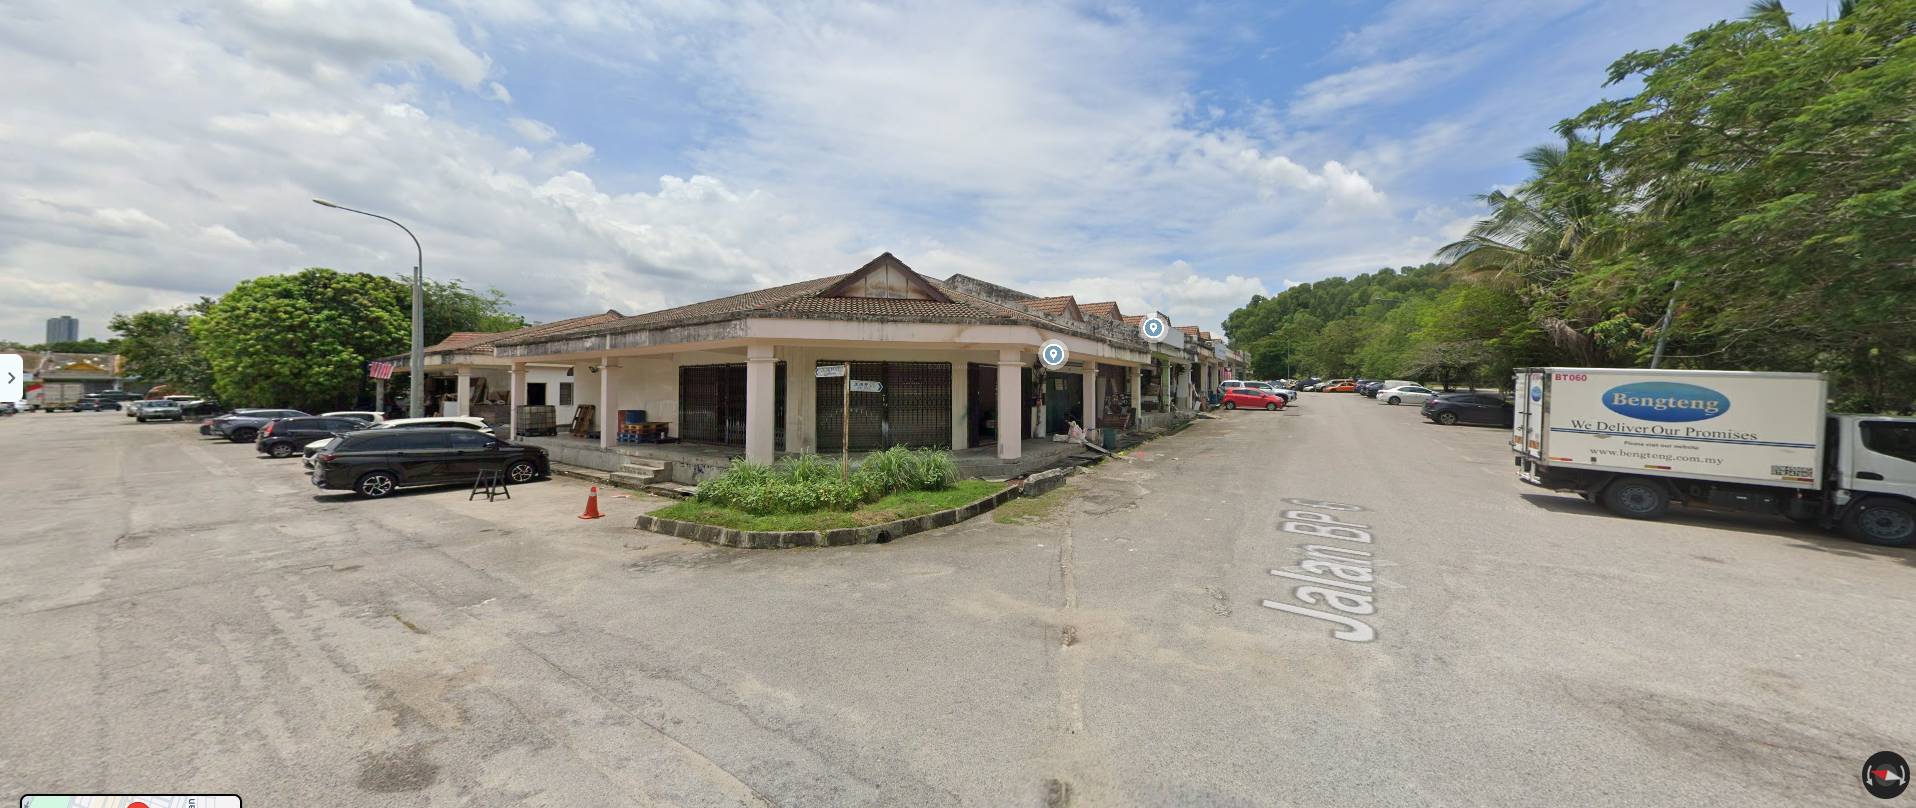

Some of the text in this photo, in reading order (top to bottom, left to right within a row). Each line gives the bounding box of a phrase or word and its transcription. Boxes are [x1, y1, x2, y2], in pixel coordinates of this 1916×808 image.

[1555, 374, 1587, 382] BT060
[1612, 392, 1719, 414] Bengteng
[1571, 419, 1758, 441] We Deliver Our Promises
[1590, 448, 1724, 465] www.bengteng.com.my
